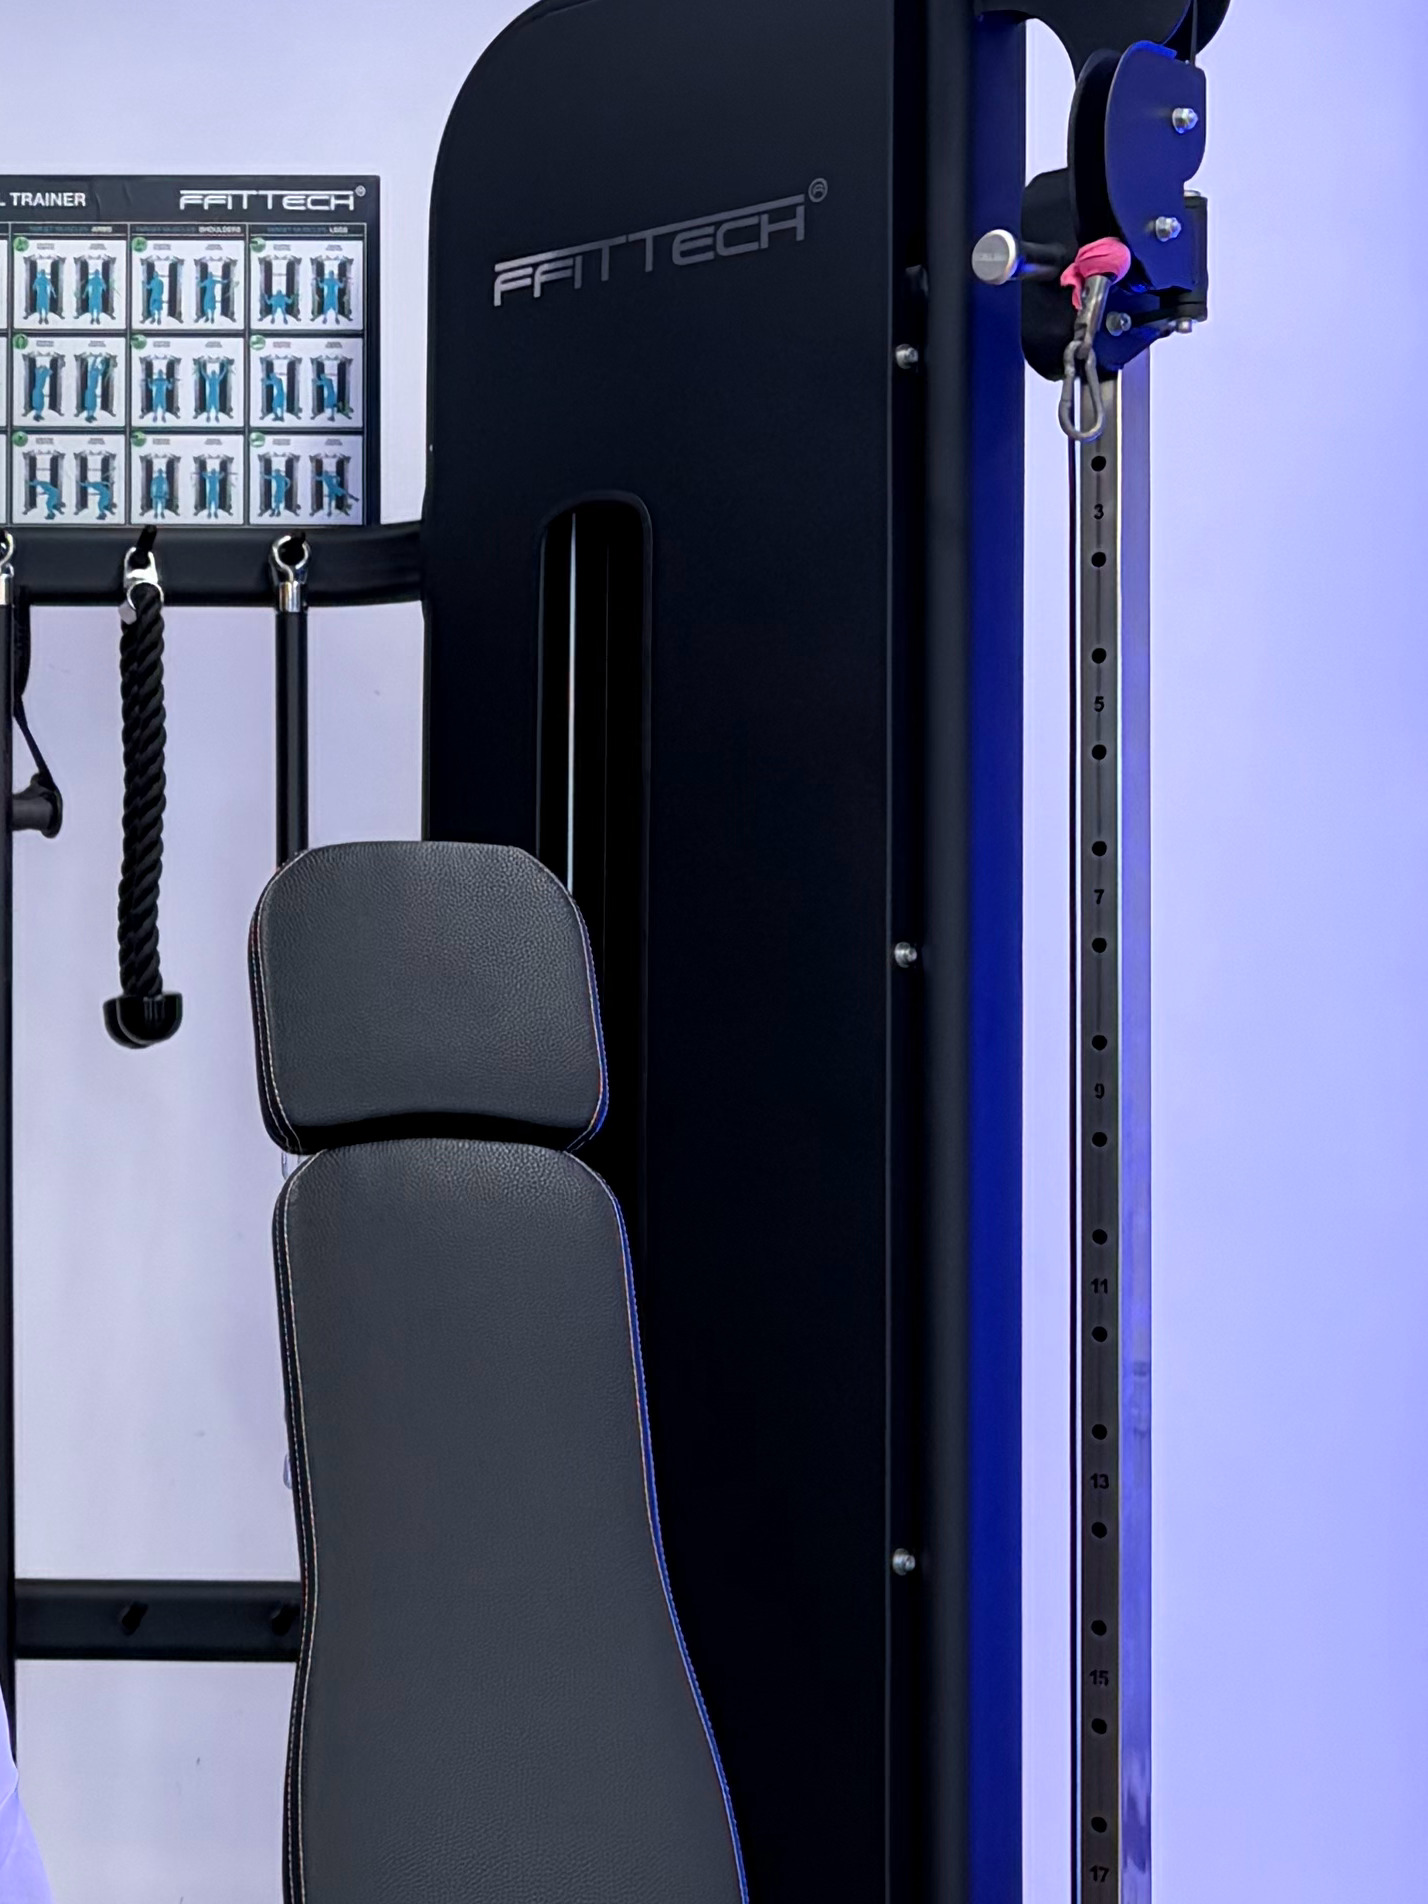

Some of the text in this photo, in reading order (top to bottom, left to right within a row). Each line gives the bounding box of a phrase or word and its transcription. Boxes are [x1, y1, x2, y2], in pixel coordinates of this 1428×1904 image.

[10, 191, 87, 208] TRAINER
[1093, 503, 1105, 520] 3
[1093, 695, 1105, 712] 5
[1093, 888, 1105, 905] 7
[1094, 1082, 1105, 1099] 9
[1090, 1277, 1109, 1294] 11
[1090, 1472, 1110, 1490] 13
[1089, 1669, 1109, 1686] 15
[1089, 1865, 1110, 1883] 17
